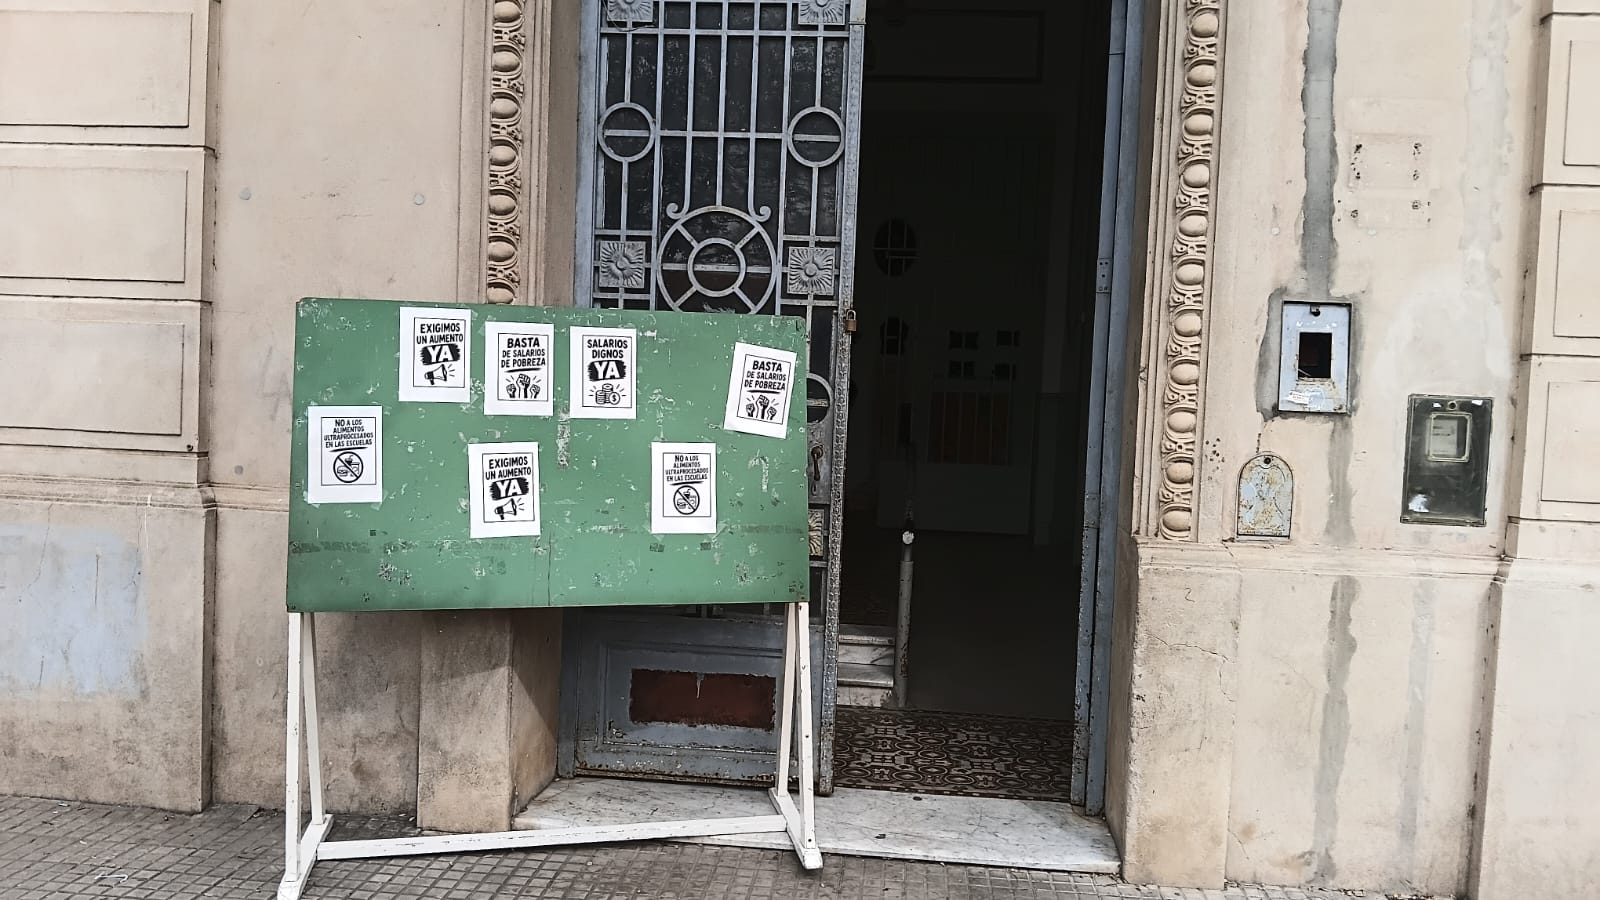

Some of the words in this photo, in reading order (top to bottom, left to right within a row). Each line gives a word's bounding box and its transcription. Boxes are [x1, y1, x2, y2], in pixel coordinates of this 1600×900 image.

[421, 323, 460, 333] EXIGIMOS
[417, 335, 427, 344] UN
[430, 334, 463, 343] AUMENTO
[507, 338, 540, 348] BASTA
[587, 339, 628, 349] SALARIOS
[427, 345, 454, 362] YA
[502, 350, 511, 358] DE
[513, 349, 545, 357] SALARIOS
[592, 349, 624, 358] DIGNOS
[501, 359, 510, 368] DE
[512, 358, 545, 367] POBREZA
[752, 360, 782, 372] BASTA
[594, 361, 620, 379] YA
[747, 371, 755, 379] DE
[757, 372, 786, 381] SALARIOS
[744, 380, 753, 388] DE
[754, 380, 785, 390] POBREZA
[335, 419, 345, 427] NO
[333, 426, 364, 434] ALIMENTOS
[346, 439, 372, 447] ESCUELAS
[489, 456, 528, 469] EXIGIMOS
[675, 455, 684, 463] NO
[486, 470, 496, 480] UN
[498, 467, 531, 478] AUMENTO
[495, 479, 523, 498] YA
